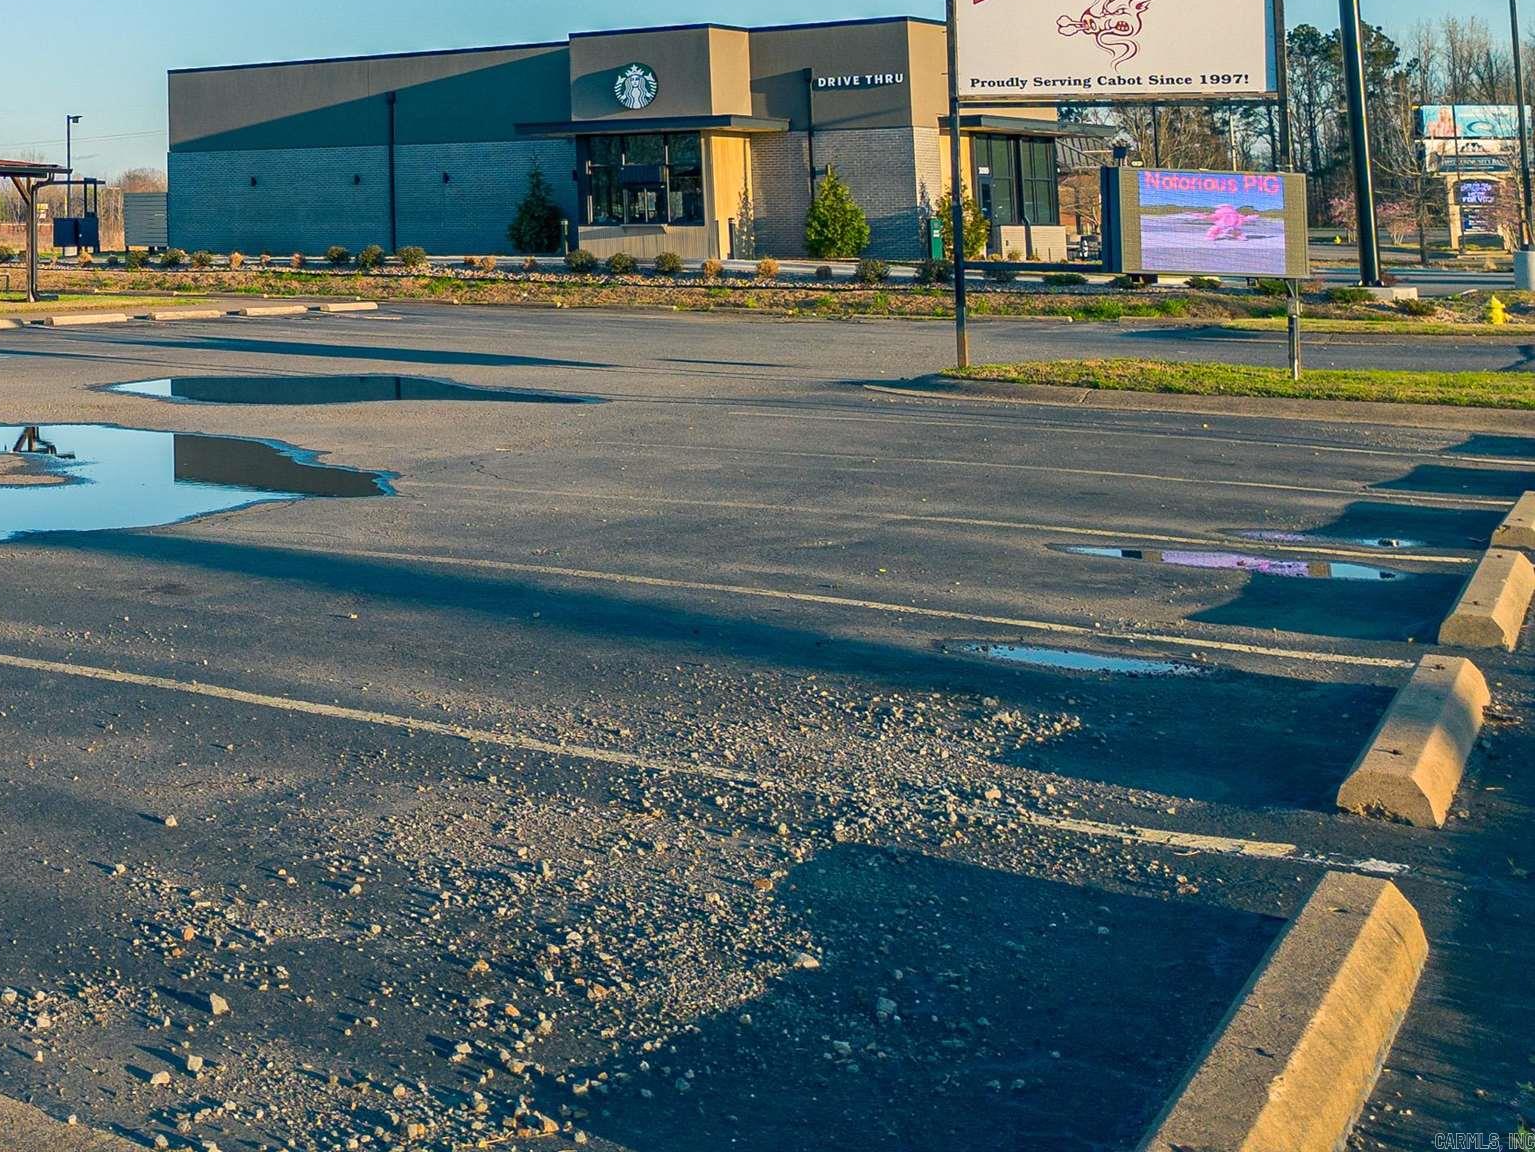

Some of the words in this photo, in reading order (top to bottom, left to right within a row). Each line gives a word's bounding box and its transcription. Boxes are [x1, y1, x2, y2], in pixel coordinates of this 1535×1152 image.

[817, 76, 860, 88] DRIVE
[865, 73, 904, 85] THRU
[970, 77, 1028, 90] Proudly
[1033, 76, 1092, 89] Serving
[1097, 75, 1143, 86] Cabot
[1148, 74, 1193, 85] Since
[1200, 74, 1249, 85] 1997!
[1144, 171, 1238, 193] Notorious
[1244, 173, 1281, 195] PIG
